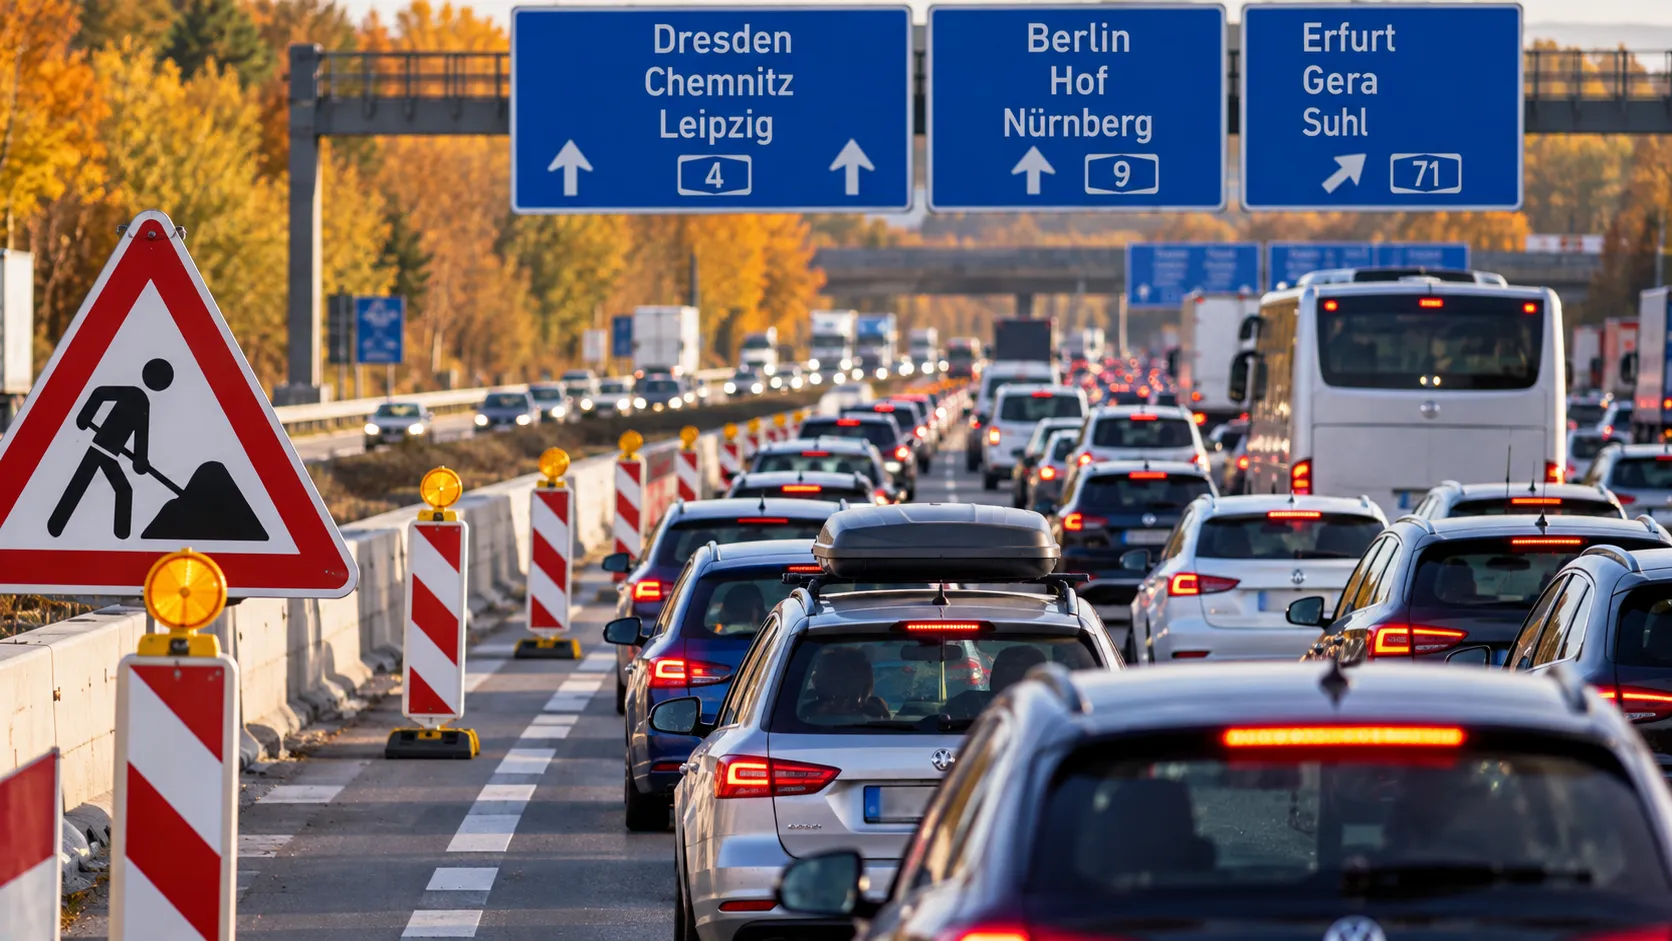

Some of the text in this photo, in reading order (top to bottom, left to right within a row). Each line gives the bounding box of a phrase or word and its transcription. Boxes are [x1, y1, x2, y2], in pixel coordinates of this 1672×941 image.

[655, 24, 792, 54] Dresden
[1028, 23, 1130, 53] Berlin
[1303, 22, 1396, 52] Erfurt
[645, 67, 794, 96] Chemnitz
[1051, 66, 1108, 95] Hof
[1303, 65, 1378, 95] Gera
[660, 109, 773, 145] Leipzig
[1004, 107, 1153, 144] Nürnberg
[1302, 107, 1368, 137] Suhl
[704, 161, 725, 189] 4
[1113, 160, 1131, 188] 9
[1412, 159, 1440, 187] 71
